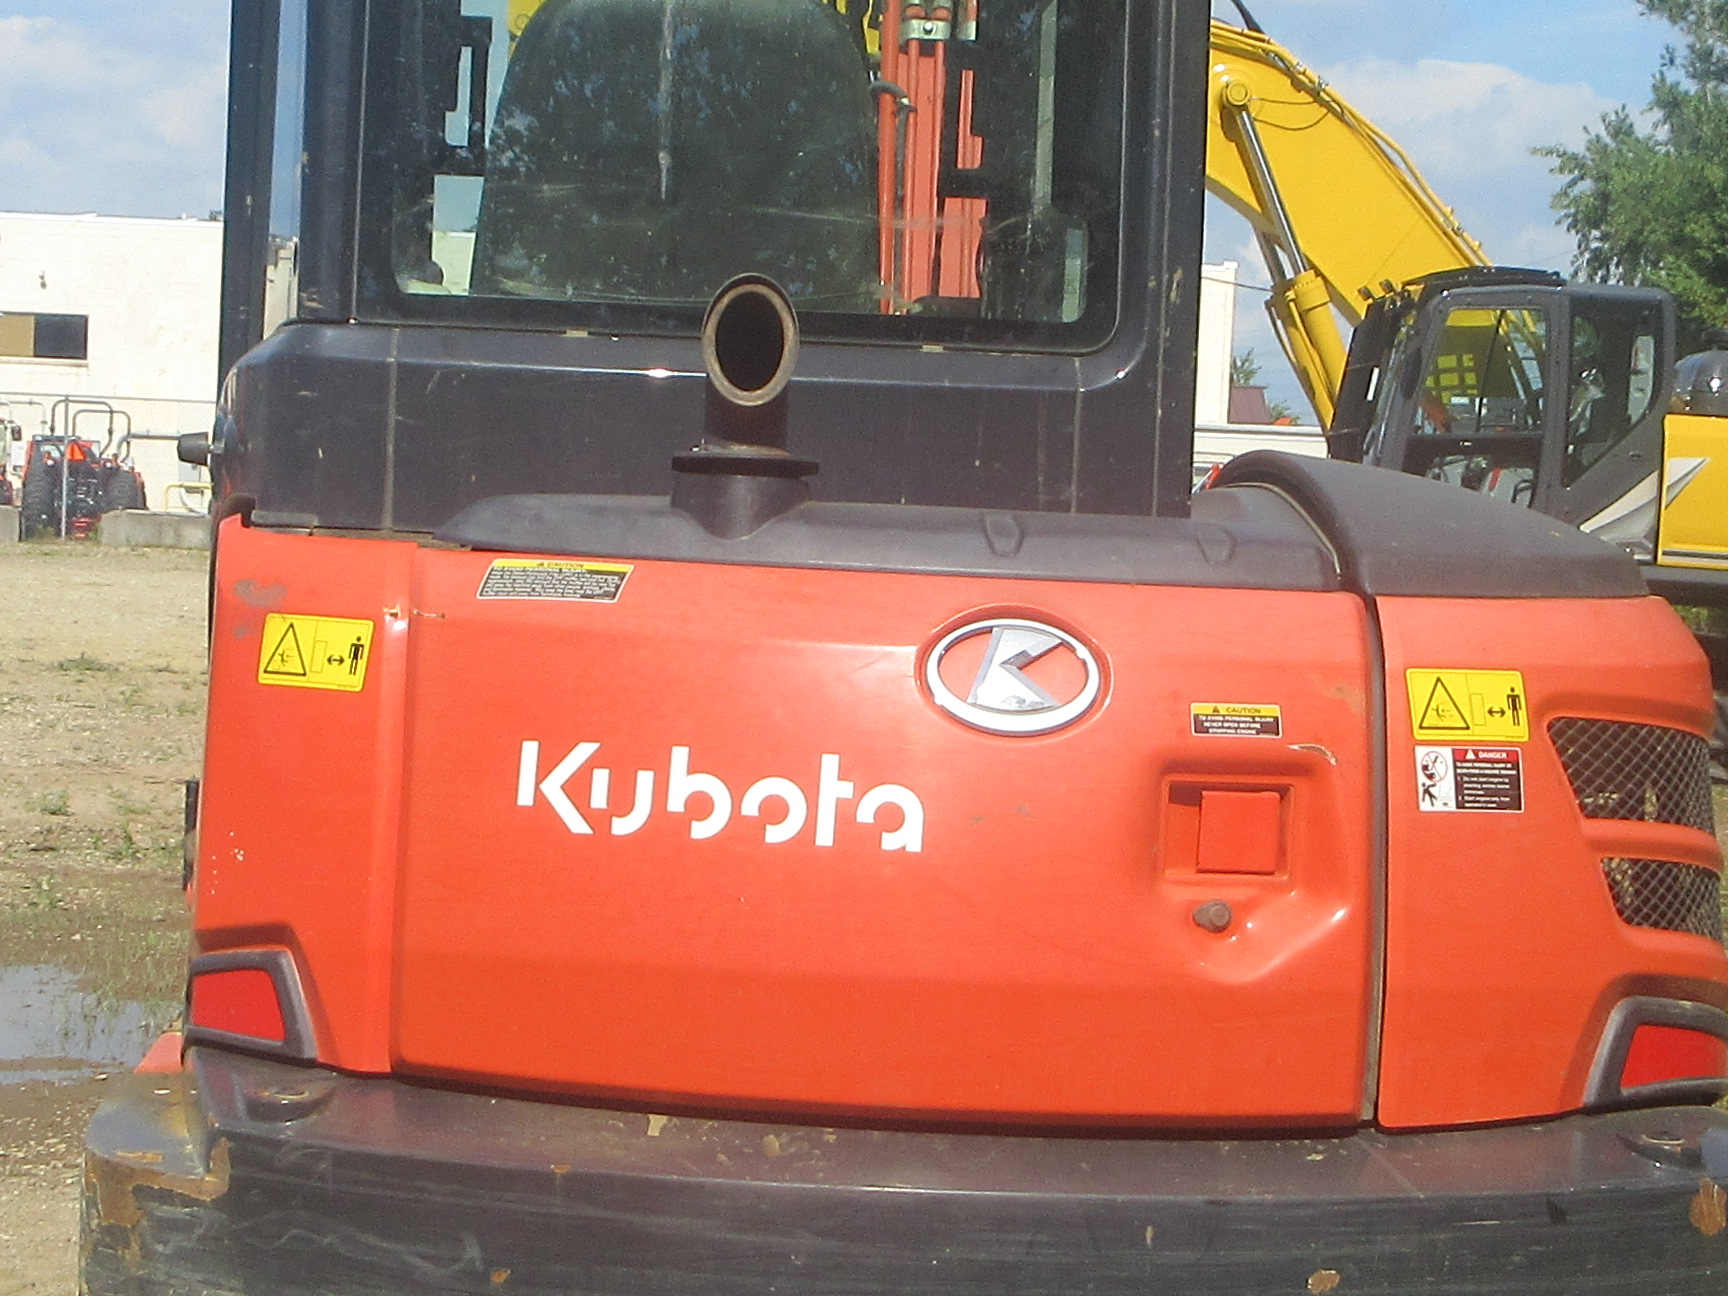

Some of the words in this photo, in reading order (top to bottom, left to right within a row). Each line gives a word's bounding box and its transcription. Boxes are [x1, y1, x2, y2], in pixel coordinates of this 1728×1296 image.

[1225, 706, 1262, 714] CAUTION
[1478, 751, 1507, 759] DANGER
[517, 740, 924, 852] Kubota
